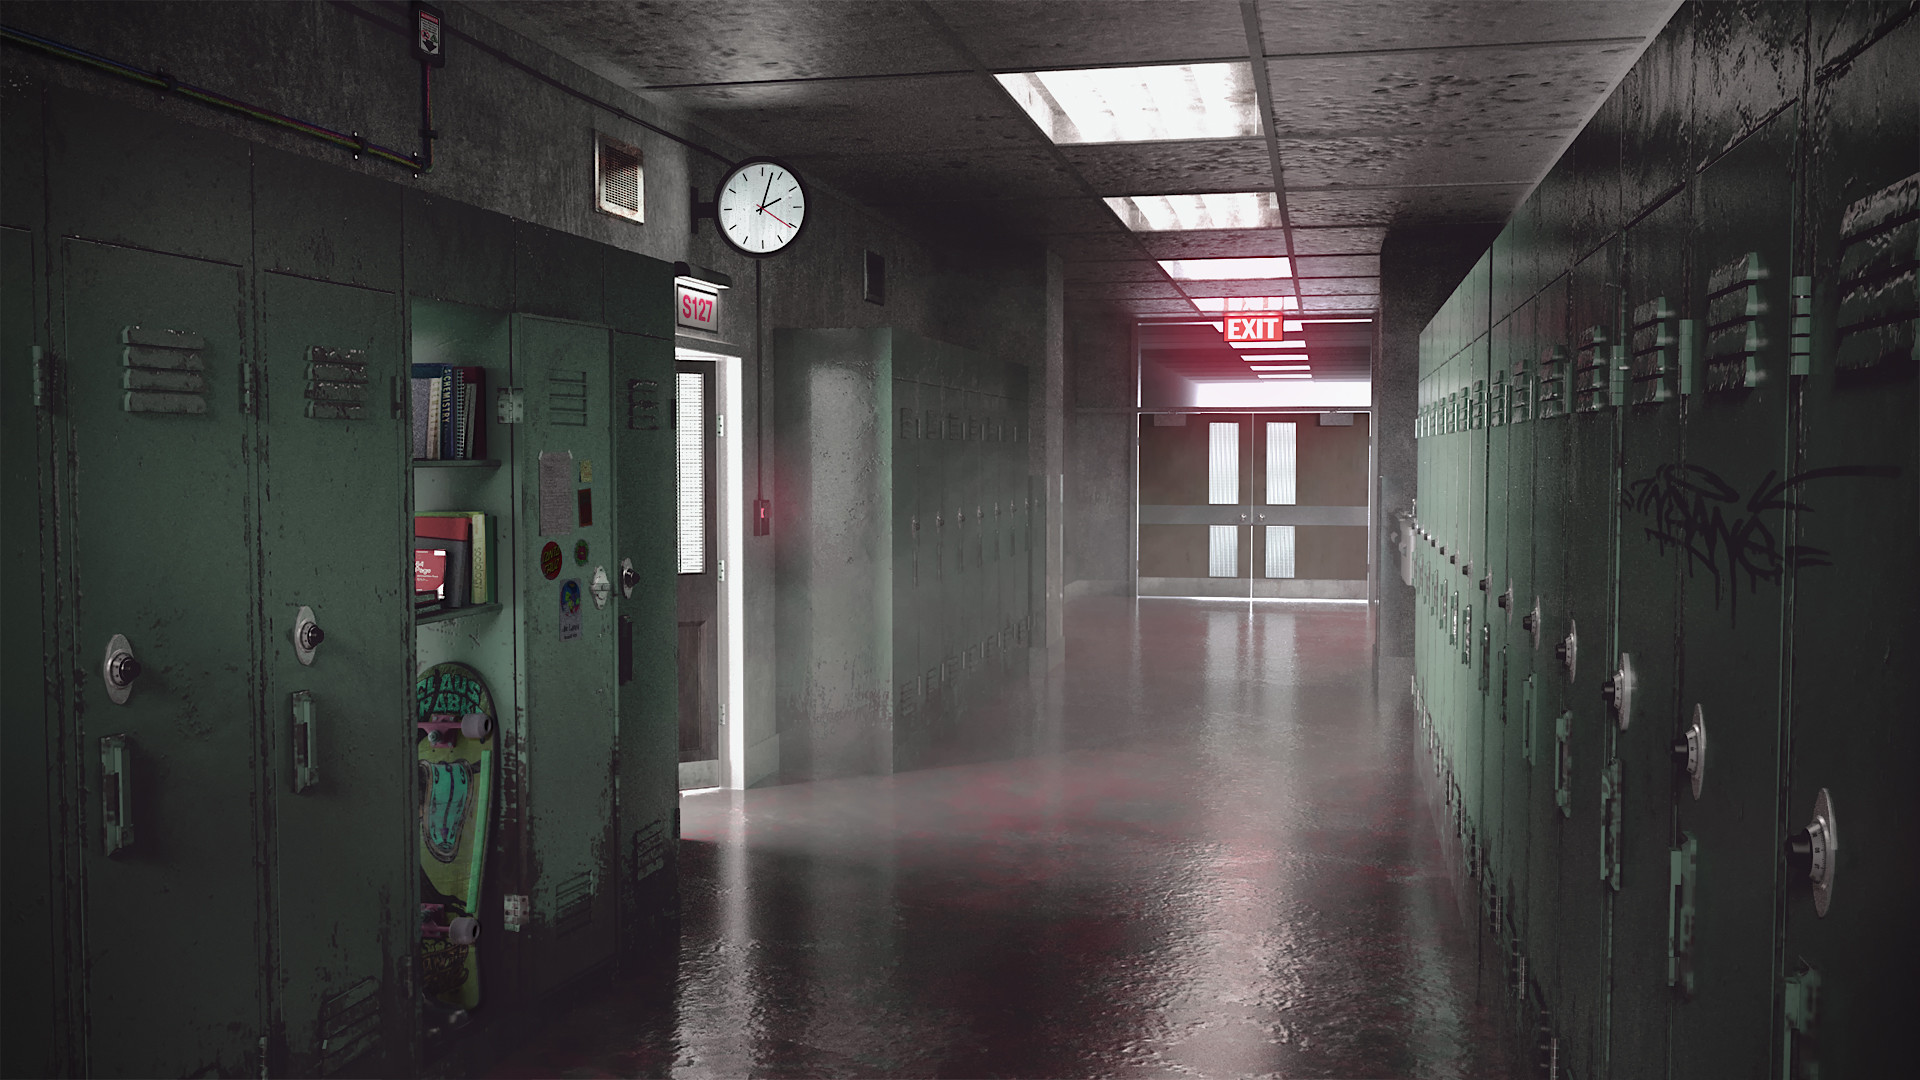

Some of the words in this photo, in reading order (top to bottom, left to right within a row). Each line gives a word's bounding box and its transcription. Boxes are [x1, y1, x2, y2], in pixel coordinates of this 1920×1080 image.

[682, 294, 713, 323] S127
[1227, 318, 1280, 340] EXIT
[442, 375, 452, 424] CHEMISTRY
[416, 672, 481, 704] CLAUS
[419, 692, 483, 717] RABK
